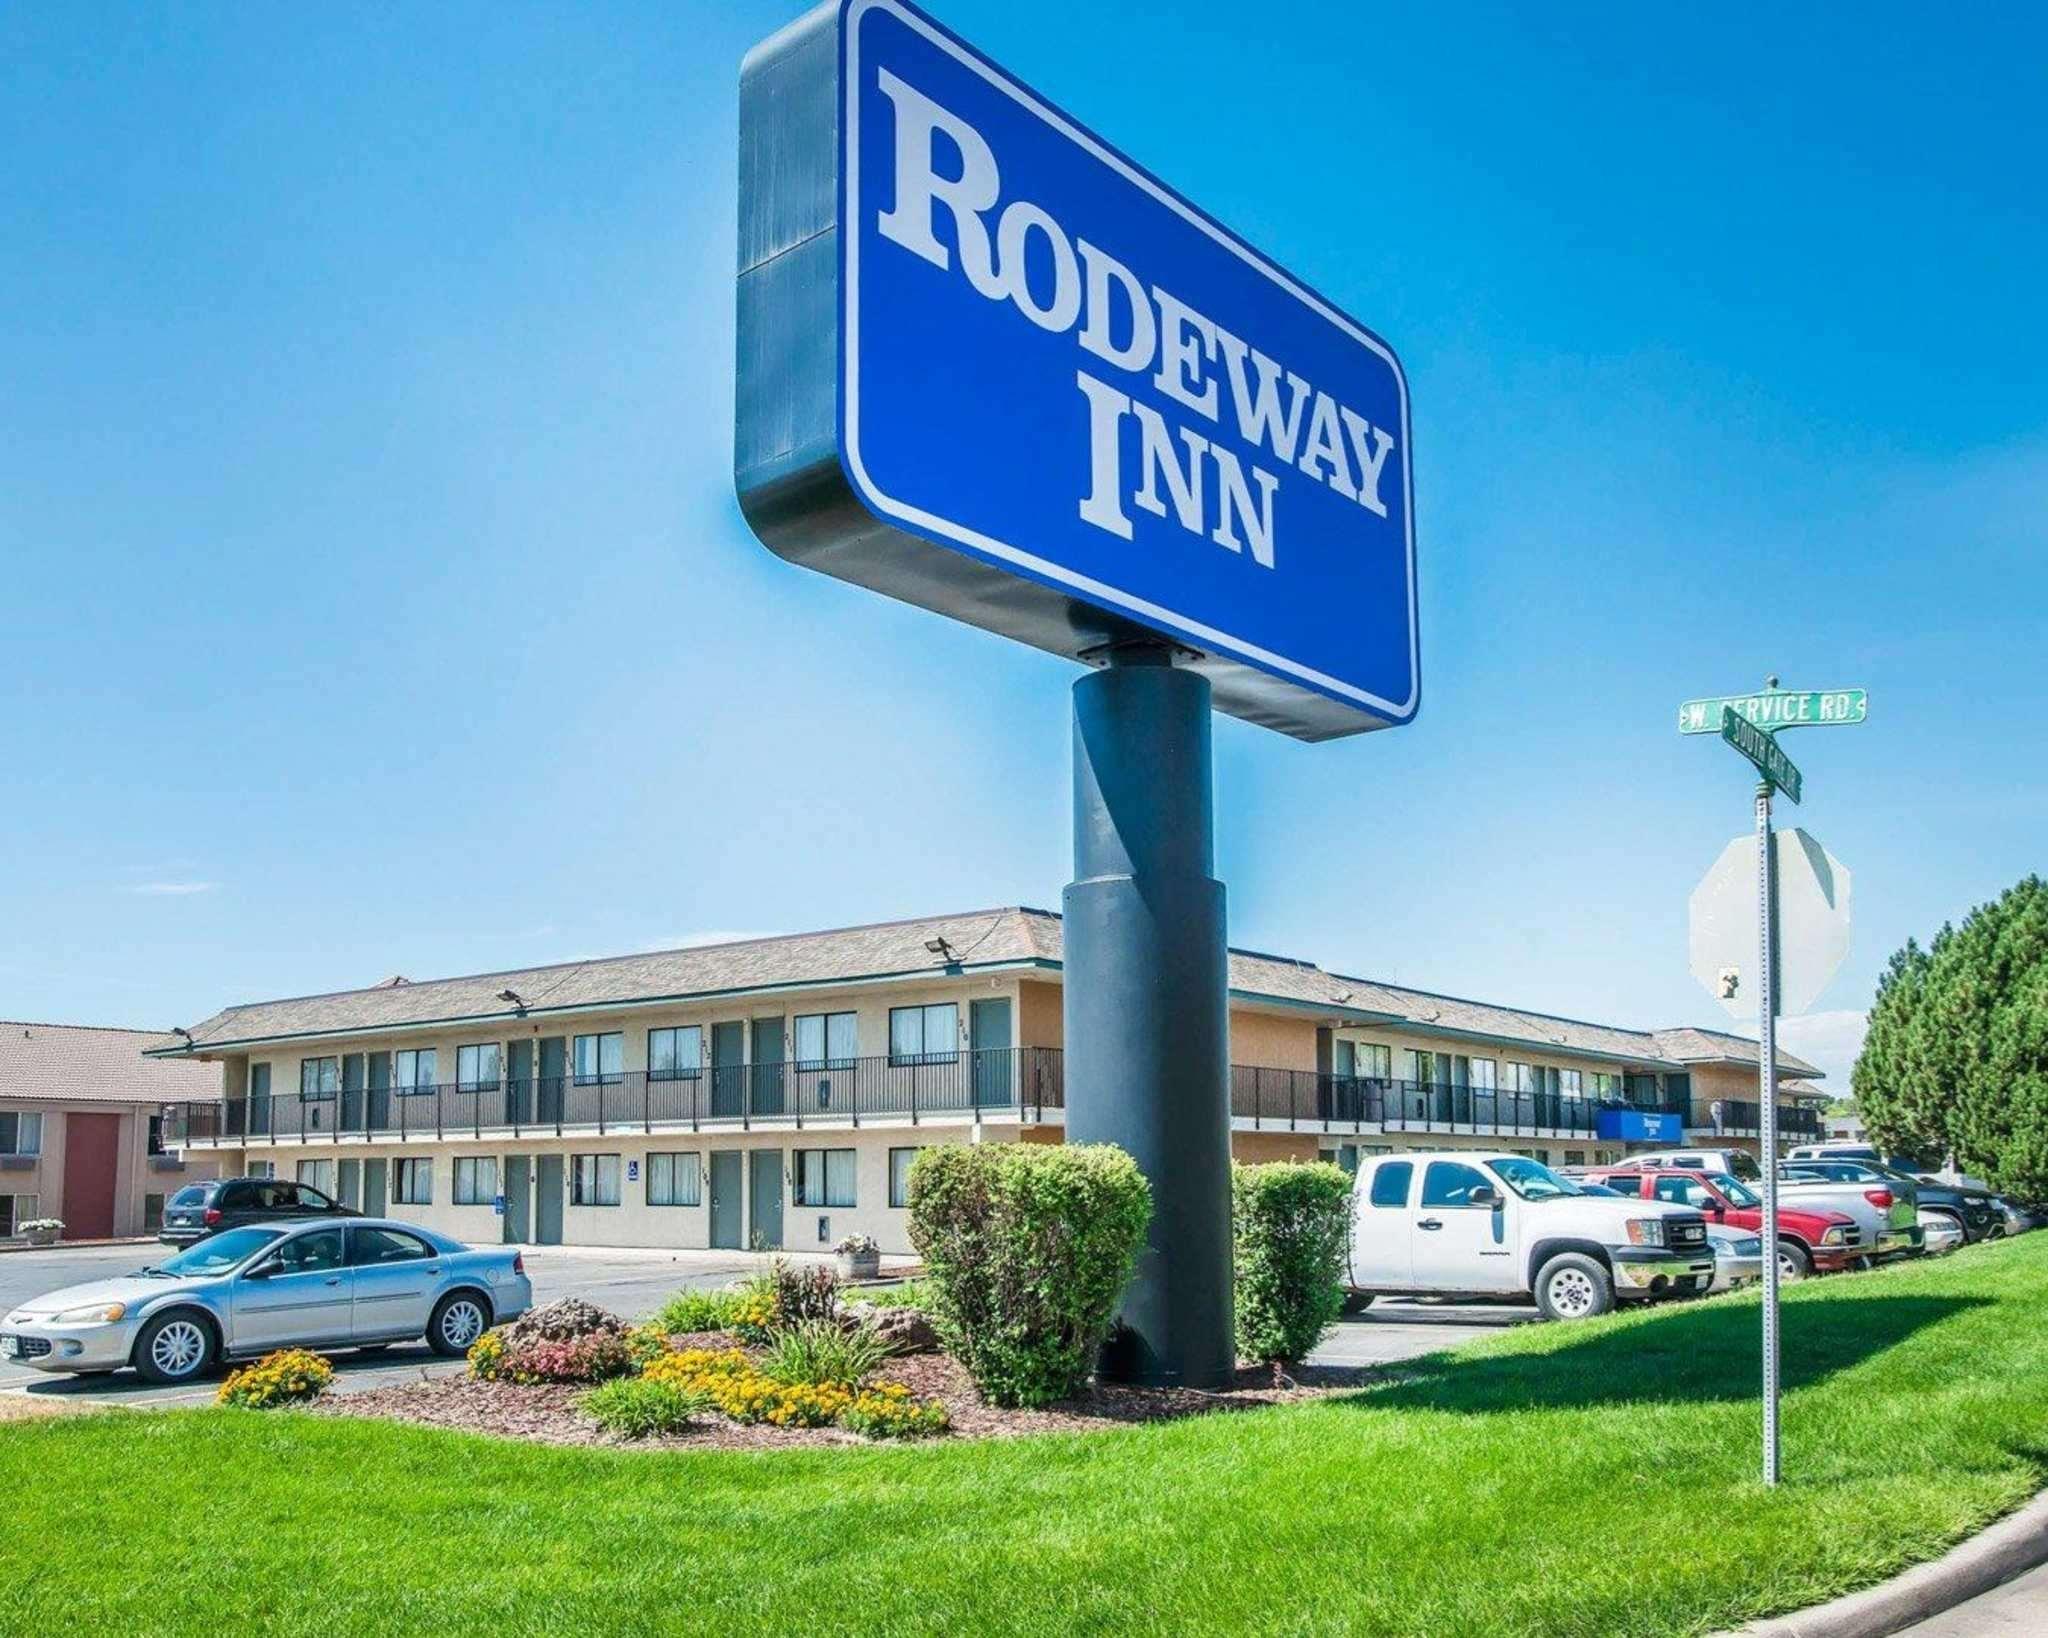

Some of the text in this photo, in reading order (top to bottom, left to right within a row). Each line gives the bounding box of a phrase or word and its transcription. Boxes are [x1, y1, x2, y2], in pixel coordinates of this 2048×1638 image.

[878, 66, 1394, 519] RODEWAY
[1077, 369, 1279, 570] INN
[1720, 694, 1811, 728] ERVICE
[1733, 716, 1767, 767] SOUTH
